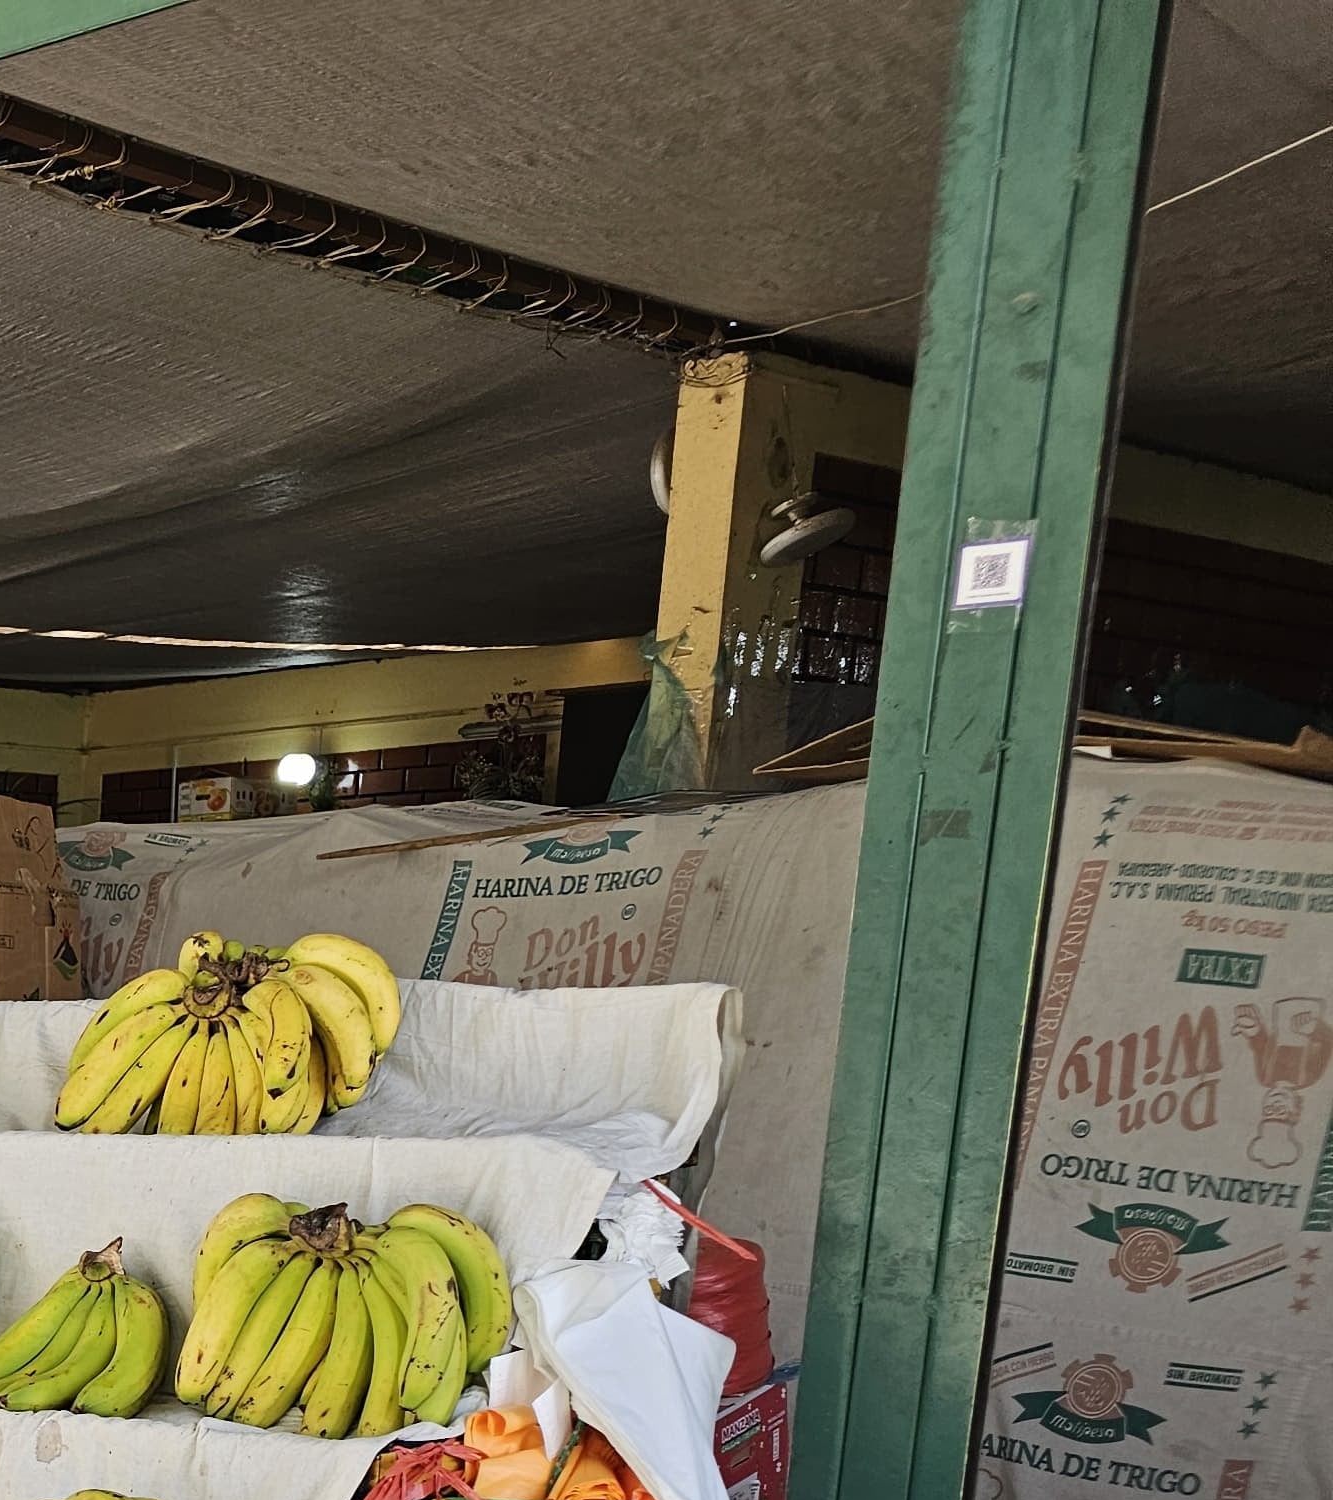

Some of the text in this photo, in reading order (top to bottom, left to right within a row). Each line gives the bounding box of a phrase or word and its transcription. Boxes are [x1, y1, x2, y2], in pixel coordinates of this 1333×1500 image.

[70, 879, 141, 901] DE TRIGO
[472, 866, 663, 899] HARINA DE TRIGO
[1109, 881, 1150, 899] S.A.C.
[1155, 883, 1215, 903] PERUANA
[1222, 885, 1303, 911] INDUSTRIAL
[430, 863, 473, 949] HARINA
[653, 853, 703, 970] PANADERA
[1056, 864, 1103, 965] HARINA
[524, 914, 601, 972] Don
[1233, 919, 1289, 939] PESO
[1186, 952, 1260, 985] EXTRA
[1033, 971, 1074, 1048] EXTRA
[1057, 1004, 1224, 1108] Willy
[1119, 1078, 1219, 1135] Don
[1040, 1153, 1302, 1209] HARINA DE TRIGO
[1005, 1257, 1077, 1278] SIN BROMATO
[1166, 1368, 1242, 1386] SIN BROMATO
[721, 1407, 761, 1444] MANZANA
[980, 1433, 1201, 1496] ARINA DE TRIGO
